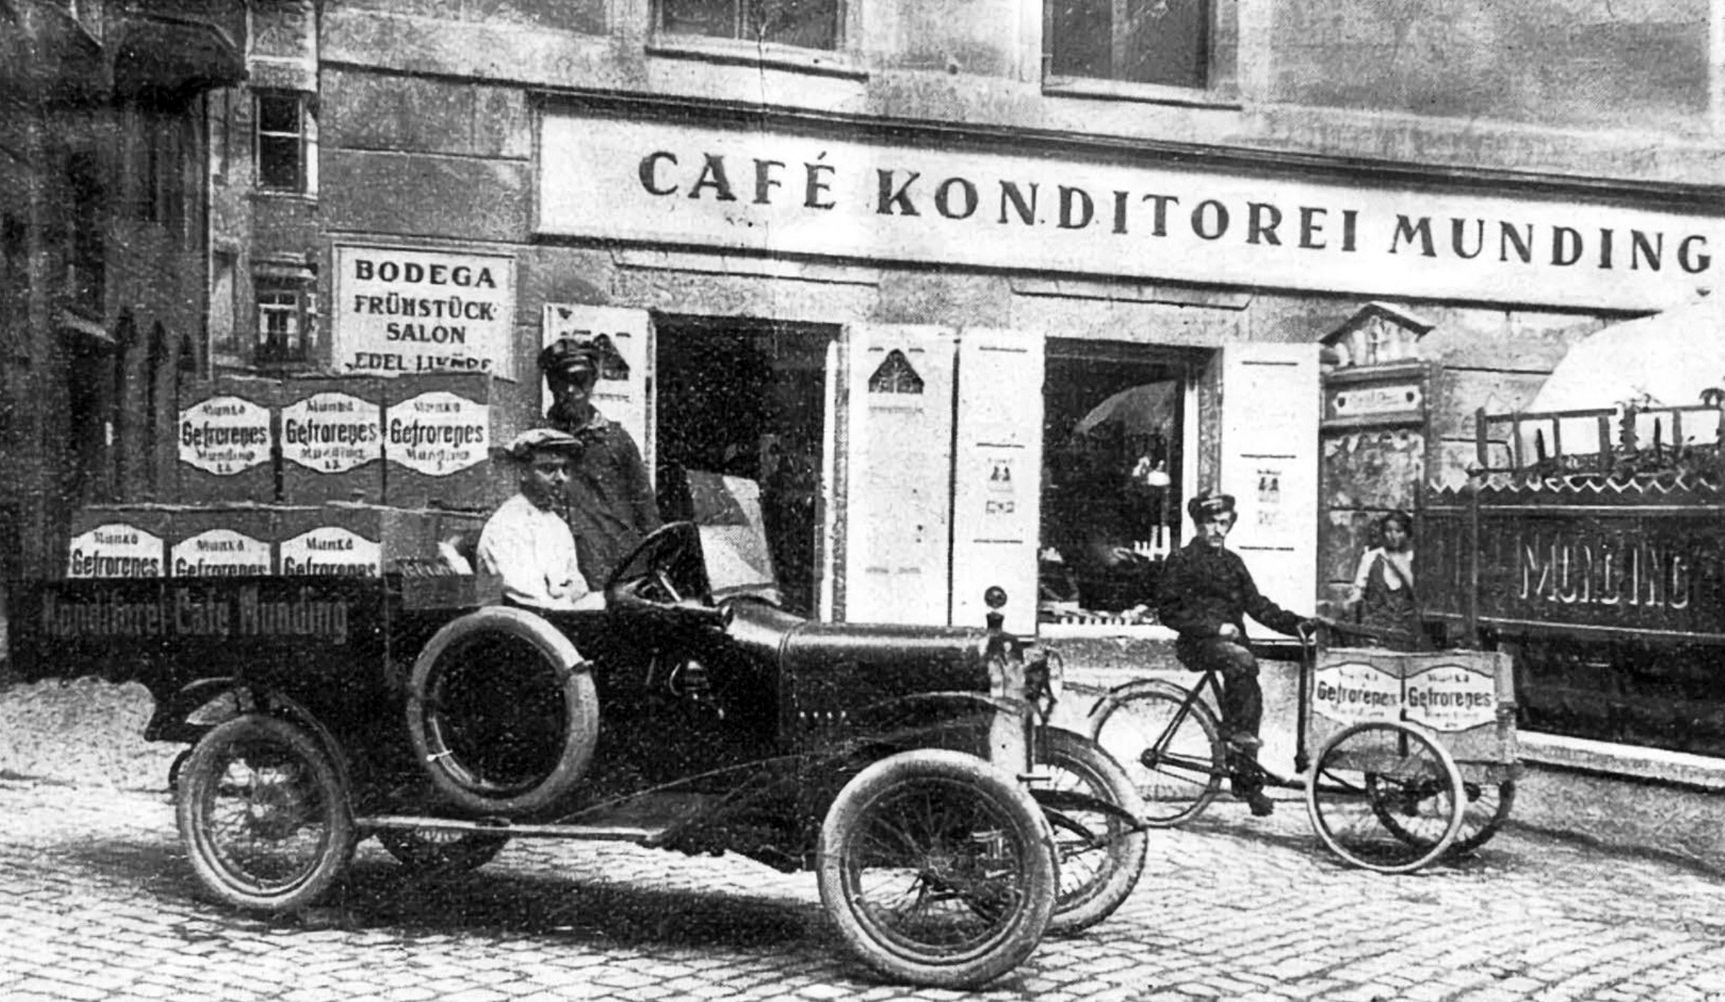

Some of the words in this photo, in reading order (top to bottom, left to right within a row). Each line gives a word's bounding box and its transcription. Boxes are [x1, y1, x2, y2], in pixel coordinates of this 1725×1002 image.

[638, 151, 837, 211] CAFÉ
[876, 168, 1359, 253] KONDITOREI
[1387, 213, 1713, 274] MUNDING
[354, 259, 497, 289] BODEGA
[386, 322, 467, 345] SALON
[182, 421, 268, 449] Gefrorenes
[285, 418, 378, 446] Gefrorenes
[390, 418, 485, 448] Gefrorenes
[1408, 686, 1492, 710] Gefrorenes
